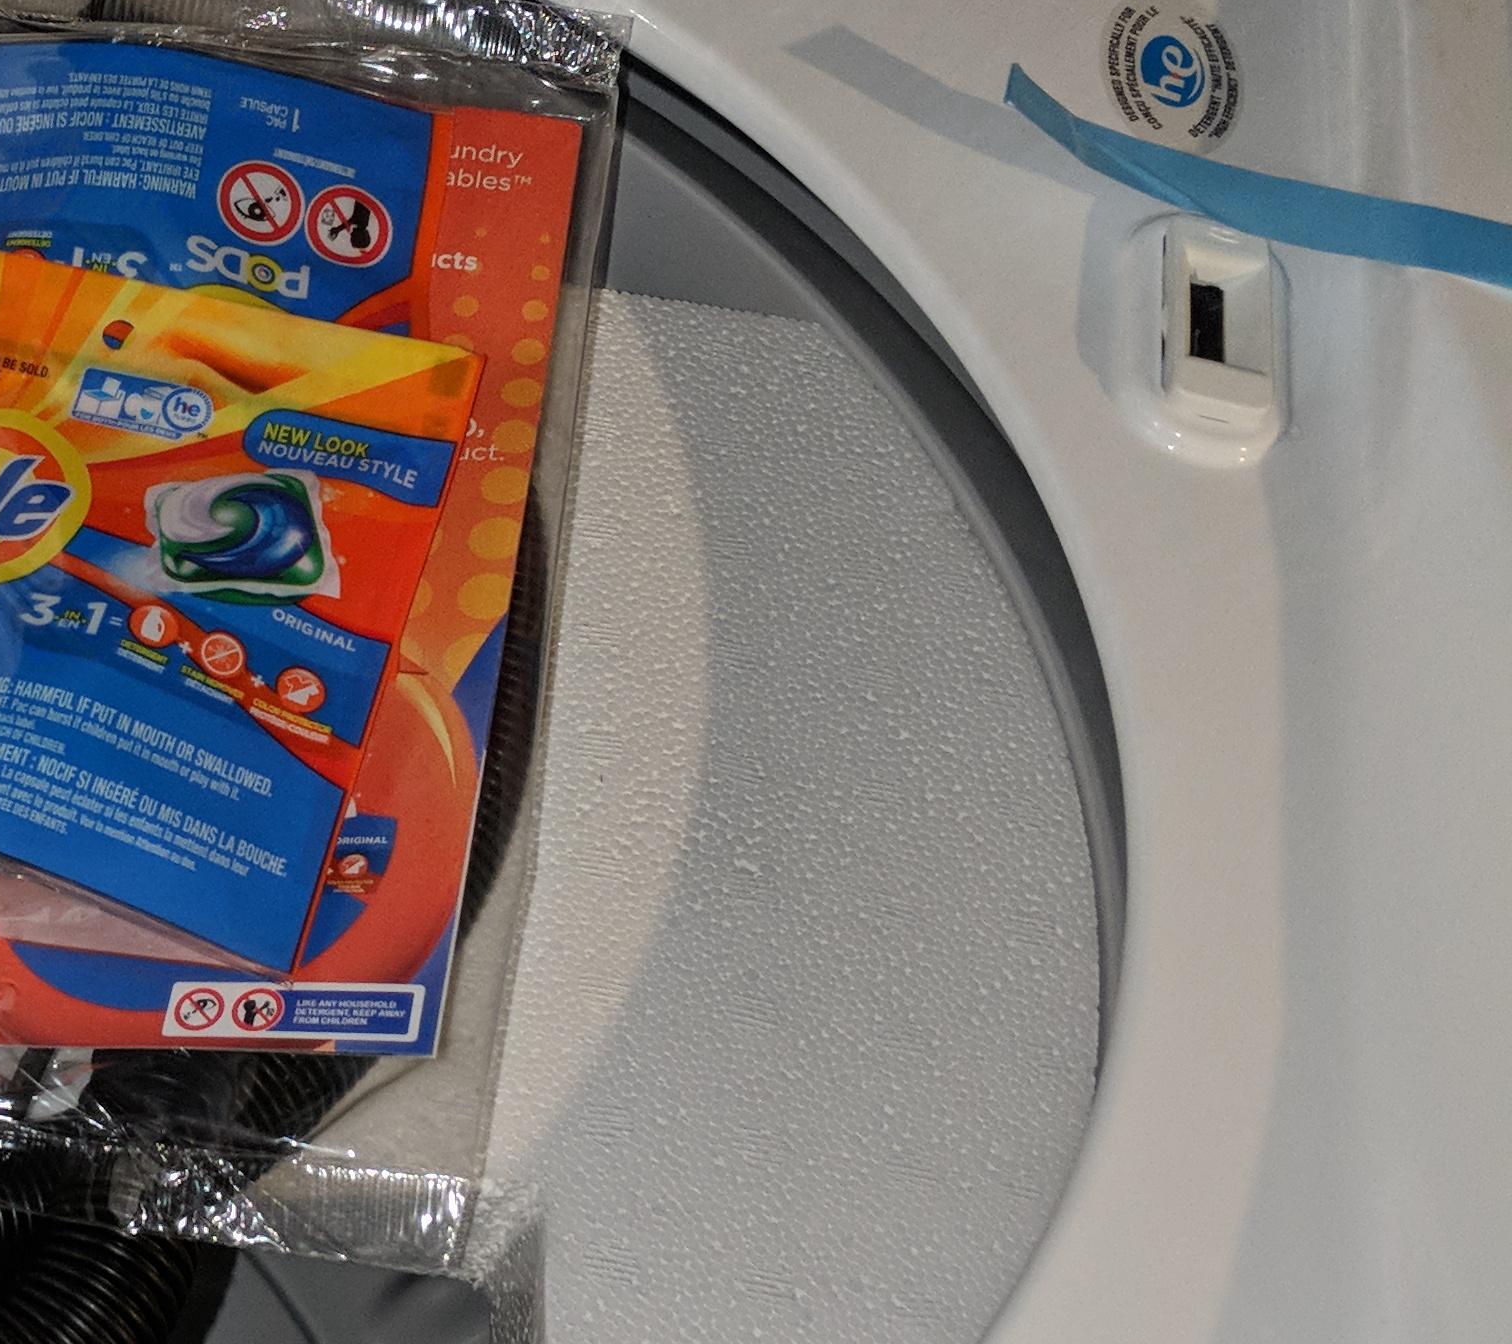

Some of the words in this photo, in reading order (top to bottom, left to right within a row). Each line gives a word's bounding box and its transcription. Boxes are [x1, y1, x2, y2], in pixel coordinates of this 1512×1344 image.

[1118, 6, 1136, 23] FOR
[1129, 14, 1149, 37] POUR
[1146, 5, 1160, 17] LE
[1108, 22, 1126, 77] SPECIFICALLY
[1112, 78, 1139, 122] DESIGNED
[185, 234, 311, 301] PODS
[431, 251, 478, 272] cts
[3, 356, 18, 371] BE
[173, 396, 201, 417] he
[262, 420, 311, 447] NEW
[314, 430, 368, 458] LOOK
[256, 440, 357, 470] NOUVEAU
[358, 455, 419, 490] STYLE
[271, 608, 356, 652] ORIGINAL
[14, 679, 75, 709] HARMFUL
[76, 695, 90, 713] IF
[90, 700, 115, 725] PUT
[116, 712, 132, 734] IN
[131, 719, 177, 755] MOUTH
[176, 739, 195, 762] OR
[195, 747, 273, 798] SWALLOWED.
[37, 755, 78, 783] NOCIF
[76, 770, 92, 791] SI
[91, 776, 140, 808] INGÉRÉ
[139, 794, 159, 817] OU
[157, 803, 184, 828] MIS
[182, 813, 218, 845] DANS
[218, 830, 238, 854] LA
[236, 838, 288, 878] BOUCHE.
[293, 1016, 319, 1024] FROM
[320, 1017, 368, 1025] CHILDREN
[294, 1007, 351, 1017] DETERGENT,
[352, 1008, 378, 1017] KEEP
[378, 1009, 406, 1018] AWAY
[296, 999, 317, 1007] LIKE
[338, 1000, 397, 1009] HOUSEHOLD
